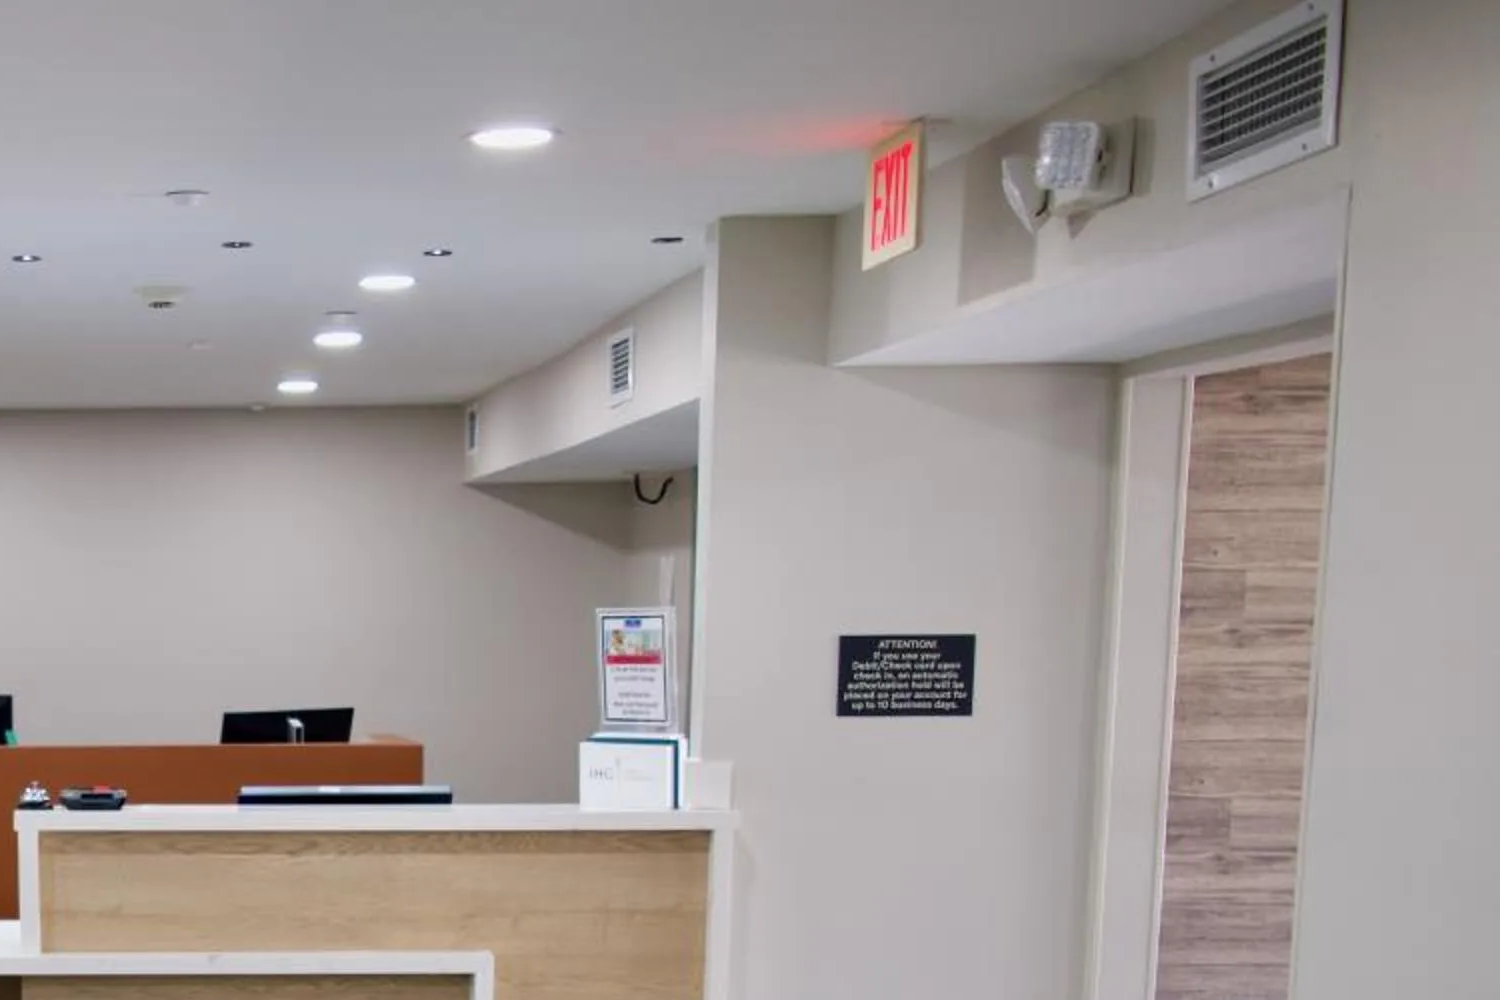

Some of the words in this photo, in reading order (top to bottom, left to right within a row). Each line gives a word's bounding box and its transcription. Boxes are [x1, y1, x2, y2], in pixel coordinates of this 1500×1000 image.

[871, 141, 914, 252] EXIT
[873, 651, 881, 660] If
[882, 653, 899, 662] you
[920, 653, 941, 662] your
[914, 662, 935, 670] card
[937, 662, 961, 671] upon
[853, 671, 882, 679] check
[897, 671, 911, 679] an
[912, 671, 959, 679] automatic
[847, 681, 909, 690] authorization
[911, 681, 933, 689] hold
[934, 681, 951, 689] will
[951, 681, 965, 689] be
[844, 691, 875, 701] placed
[891, 692, 912, 701] your
[953, 691, 968, 699] for
[851, 702, 865, 712] up
[866, 701, 876, 709] to
[877, 701, 889, 709] 10
[891, 701, 933, 709] business
[933, 701, 958, 711] days.
[589, 767, 614, 781] IHG
